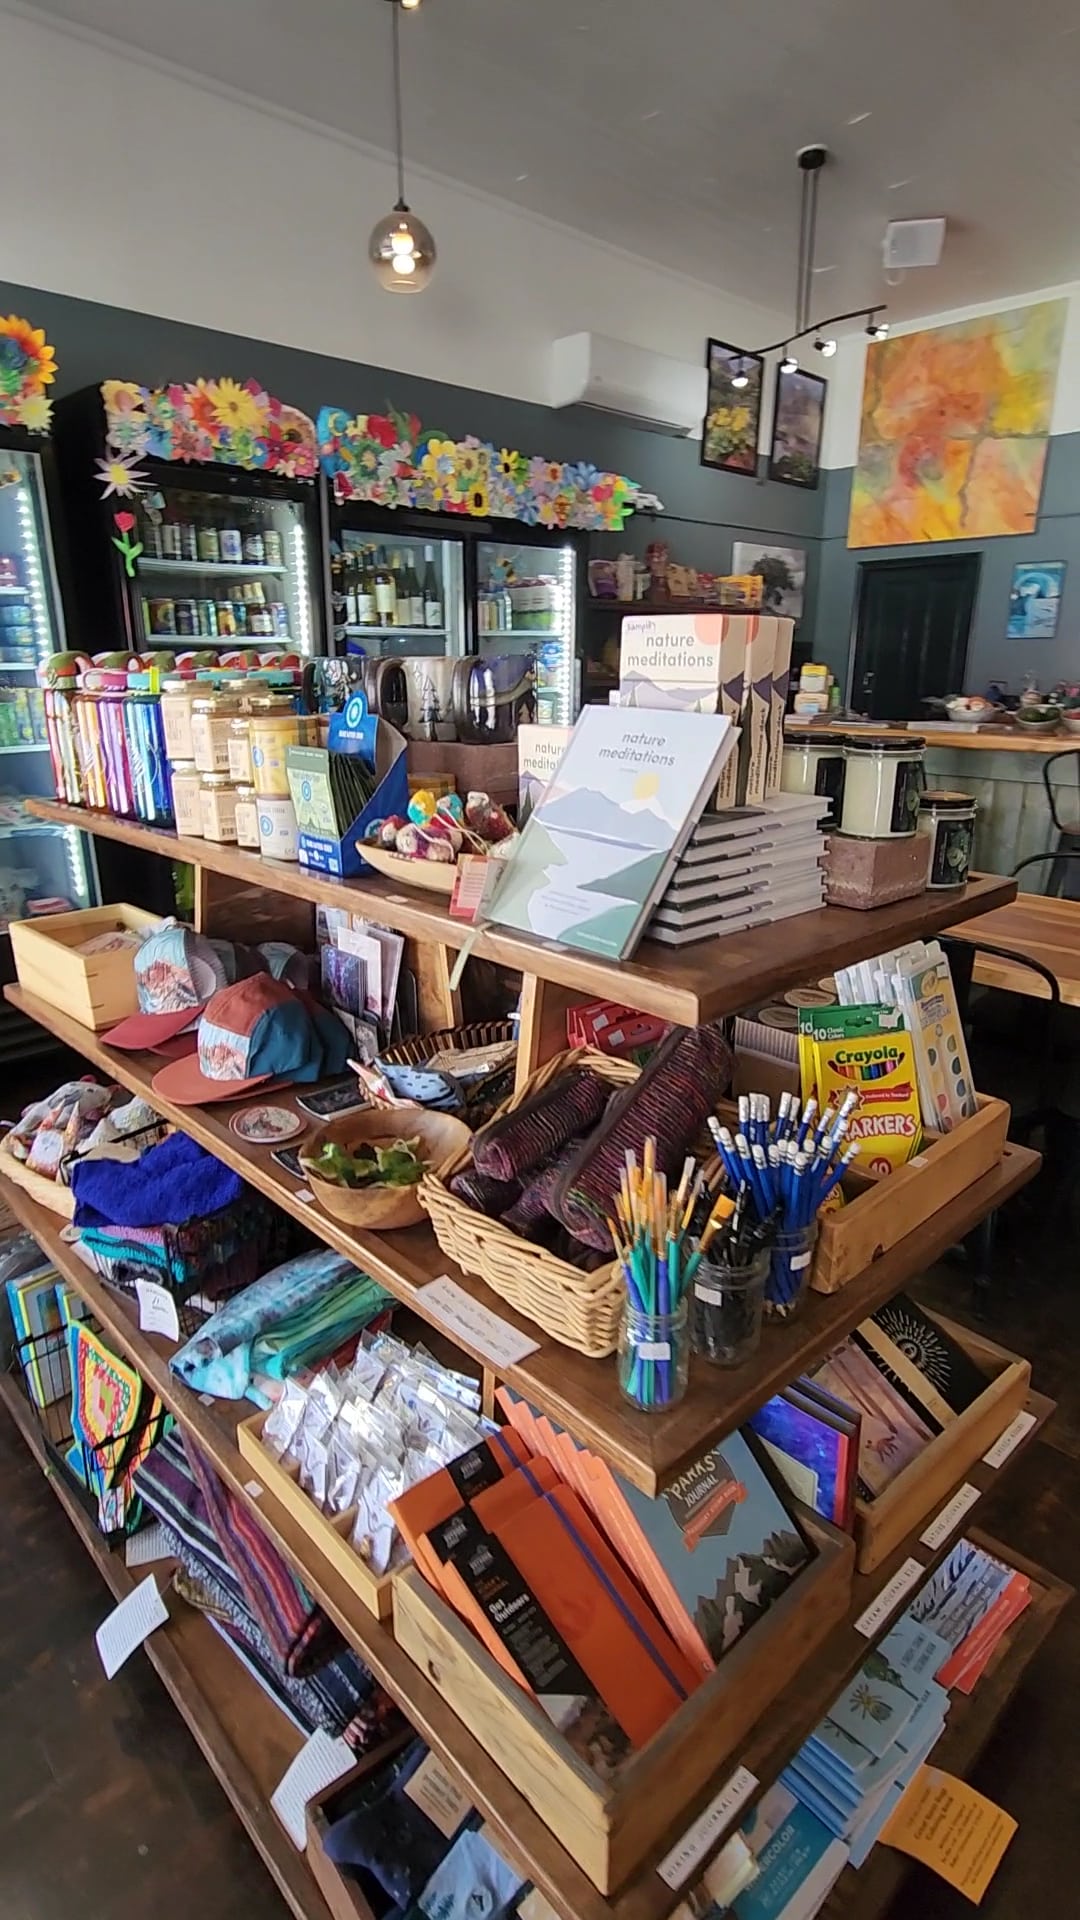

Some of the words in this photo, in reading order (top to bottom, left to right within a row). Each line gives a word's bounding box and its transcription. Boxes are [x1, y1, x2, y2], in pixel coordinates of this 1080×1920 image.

[646, 632, 695, 648] nature
[627, 651, 714, 668] meditations
[621, 731, 666, 747] nature
[598, 746, 676, 768] meditations
[799, 1020, 813, 1034] 10
[812, 1028, 827, 1041] 10
[834, 1045, 899, 1065] Crayola
[846, 1113, 917, 1140] ARKERS
[684, 1475, 720, 1507] JOURNAL
[494, 1593, 531, 1624] Outdoors
[664, 1841, 698, 1880] HIKING
[694, 1795, 733, 1841] JOURNAL
